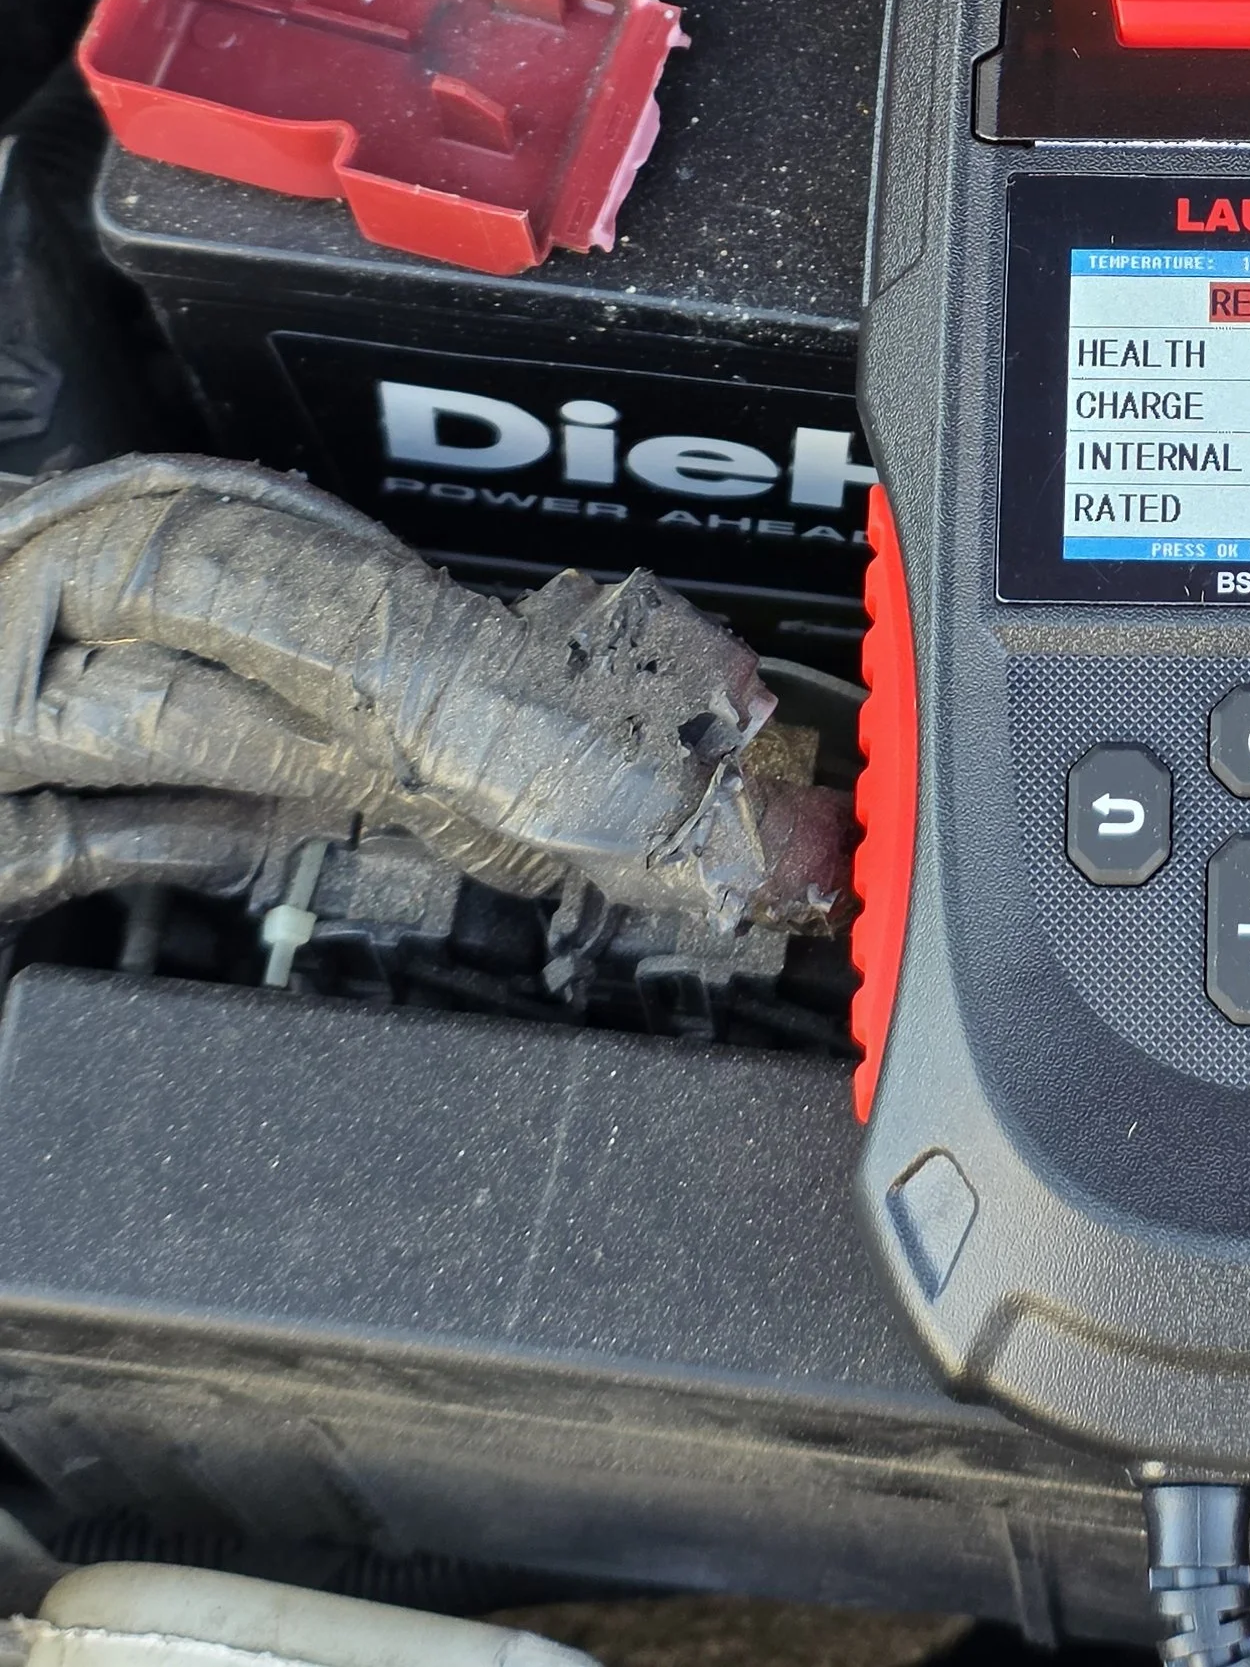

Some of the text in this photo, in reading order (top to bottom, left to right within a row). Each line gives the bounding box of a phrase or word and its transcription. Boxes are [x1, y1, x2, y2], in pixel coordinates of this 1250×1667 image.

[1089, 254, 1215, 271] TEMPERATURE:
[1078, 339, 1206, 369] HEALTH
[1076, 391, 1203, 421] CHARGE
[1078, 442, 1242, 472] INTERNAL
[384, 476, 868, 545] POWER AHEA
[1074, 493, 1181, 523] RATED
[1151, 542, 1206, 559] PRESS
[1217, 543, 1238, 559] OK
